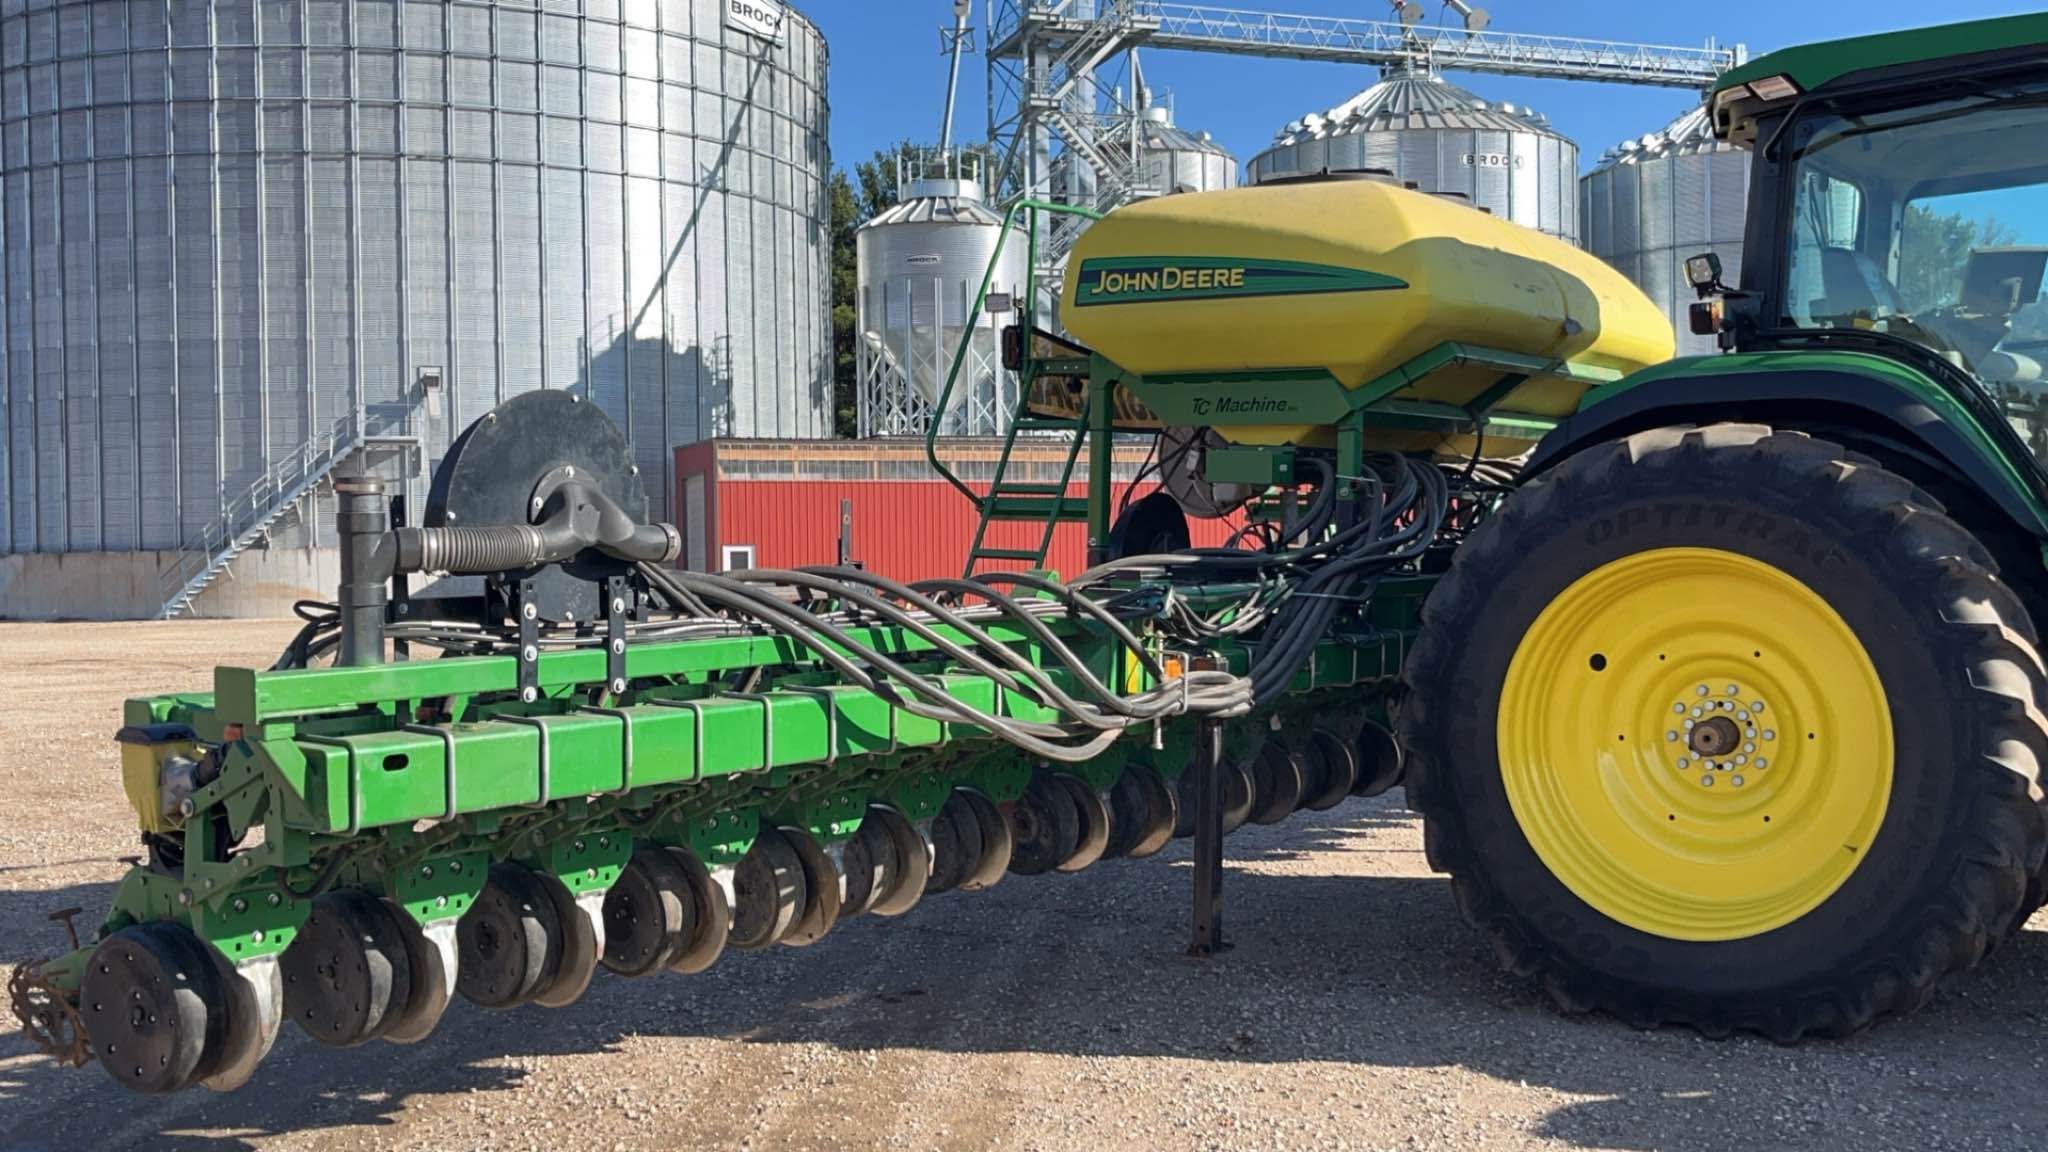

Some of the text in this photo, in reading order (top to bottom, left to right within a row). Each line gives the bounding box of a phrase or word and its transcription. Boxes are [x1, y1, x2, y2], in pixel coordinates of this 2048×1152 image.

[731, 0, 782, 32] BROCK
[1466, 154, 1522, 166] BROCK
[1091, 266, 1246, 295] JOHN DEERE
[1215, 396, 1289, 413] Machine
